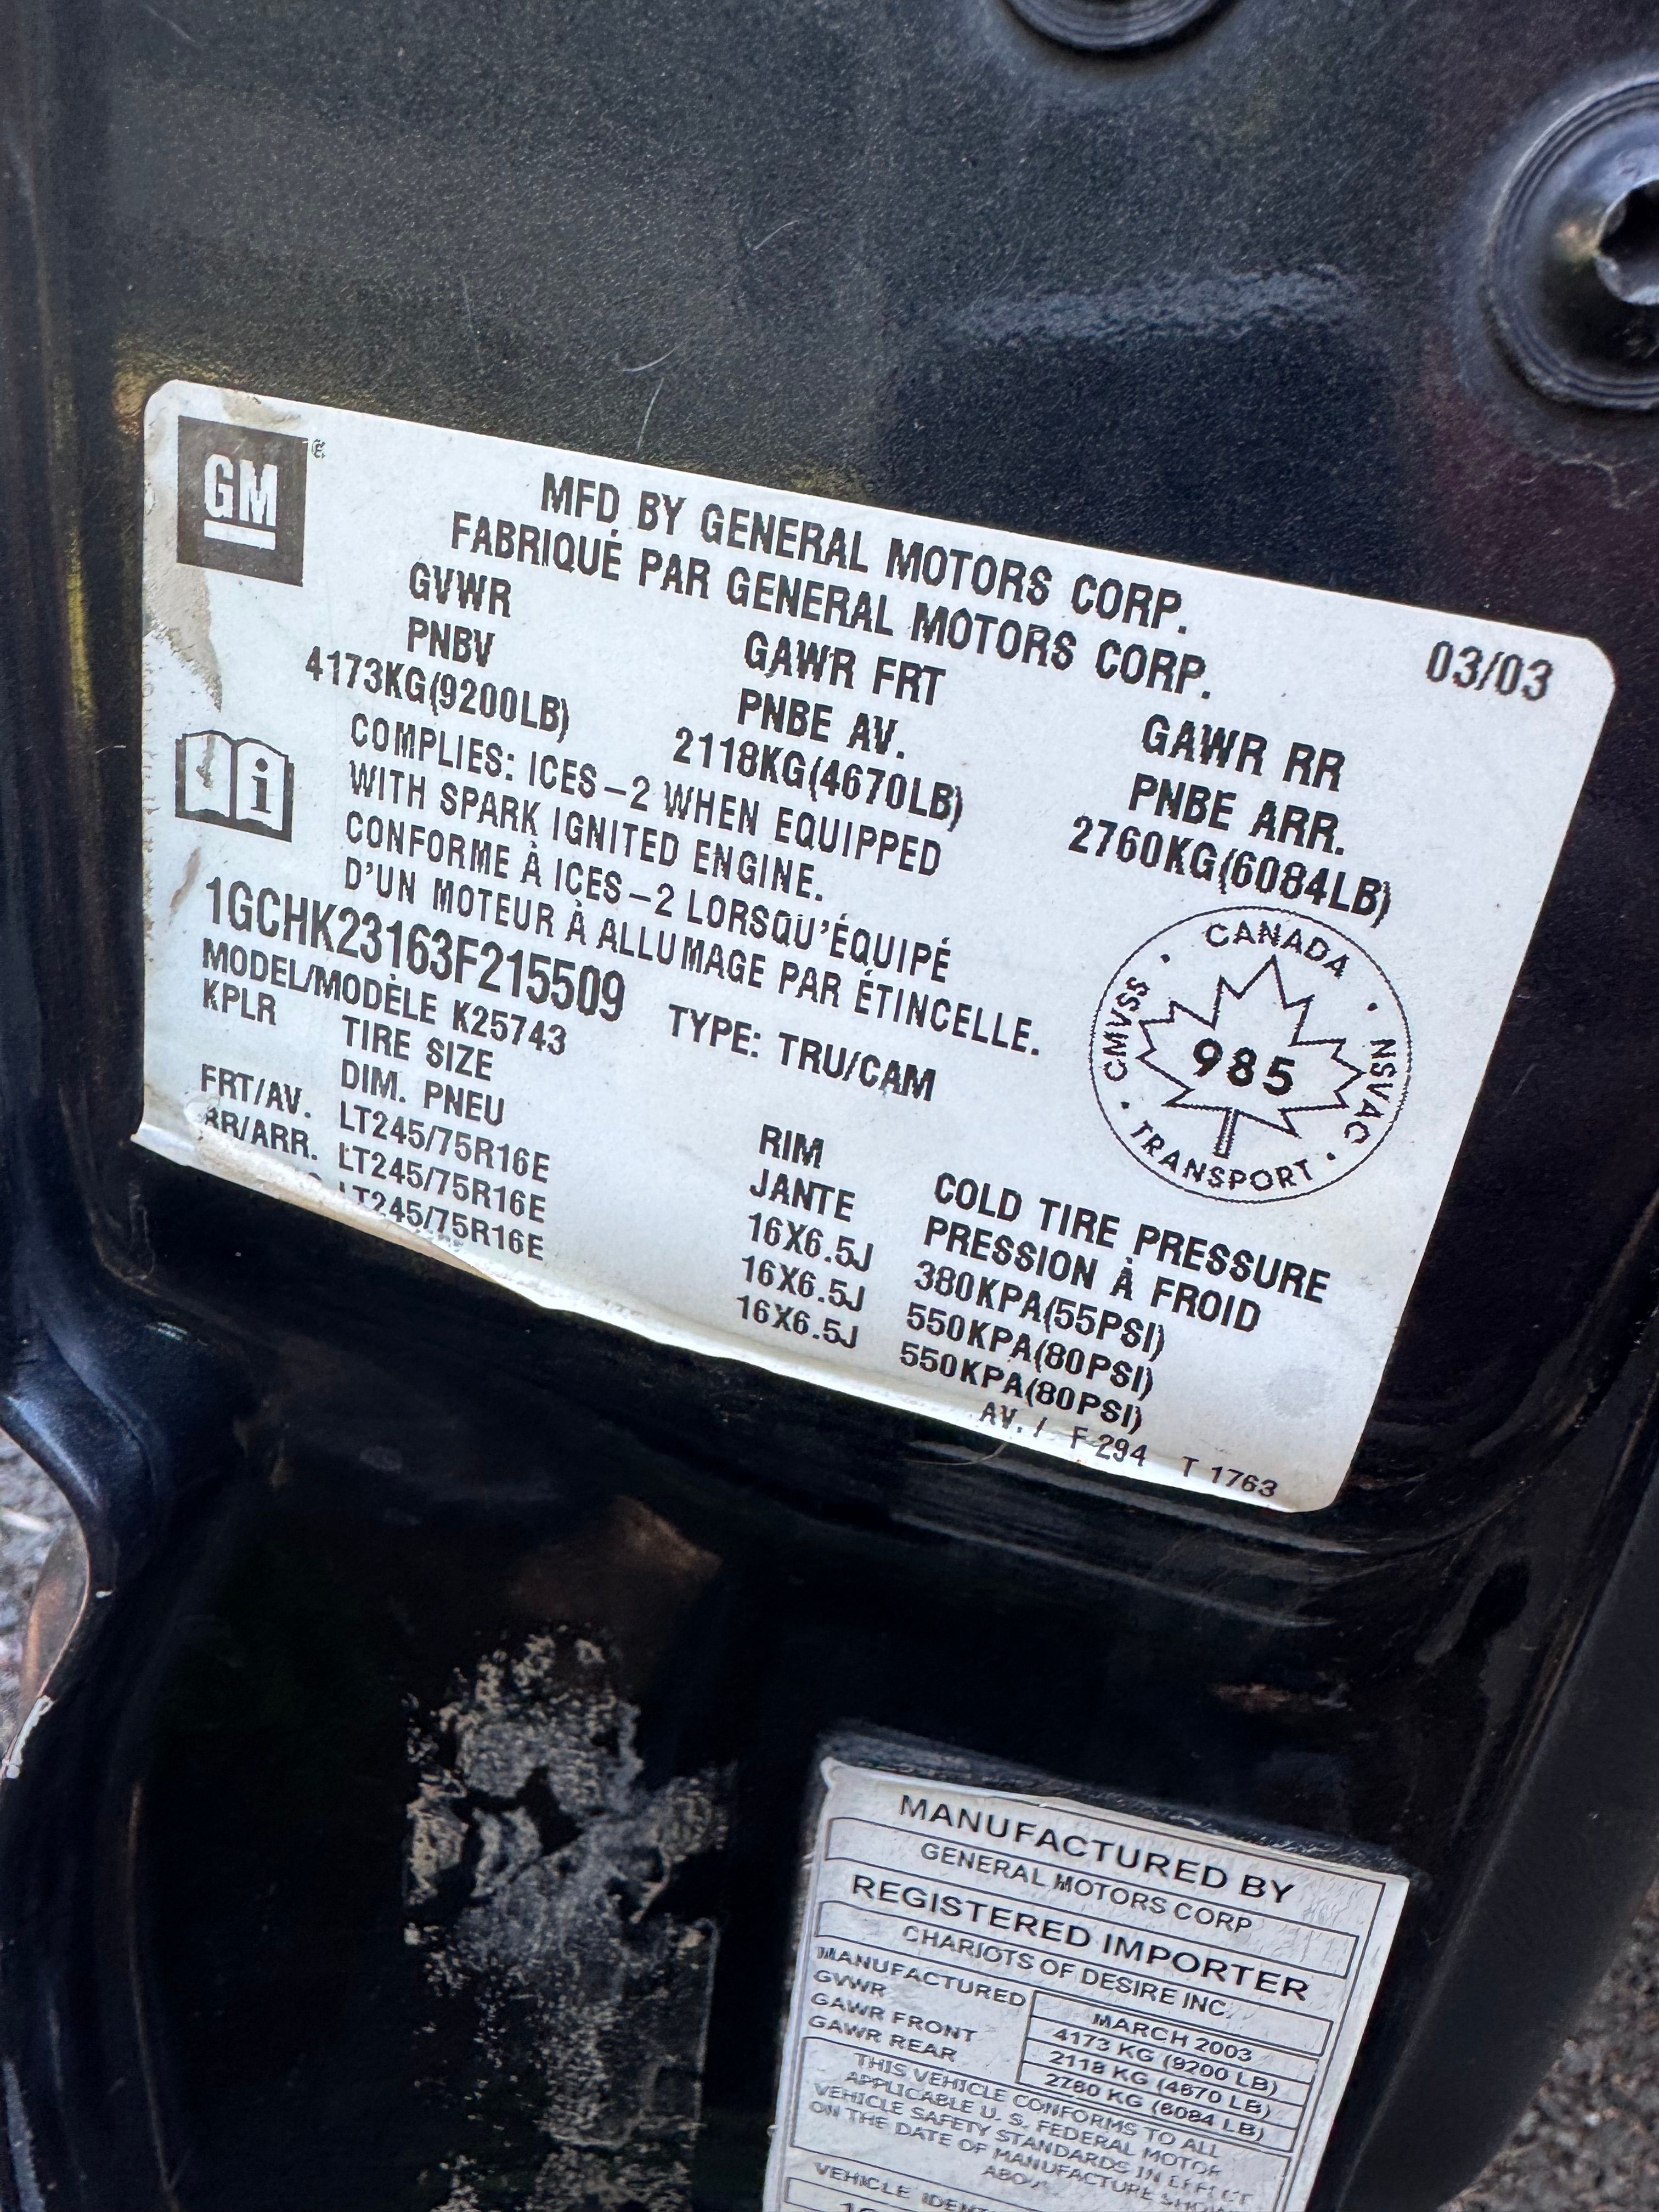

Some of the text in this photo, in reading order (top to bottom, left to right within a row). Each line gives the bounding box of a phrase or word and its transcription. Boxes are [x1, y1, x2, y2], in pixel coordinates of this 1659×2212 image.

[204, 454, 278, 527] GM
[409, 562, 511, 618] GVWR
[541, 472, 1187, 634] MFD BY GENERAL MOTORS CORP.
[408, 617, 495, 667] PNBV
[452, 511, 1210, 699] FABRIQUÉ PAR GENERAL MOTORS CORP.
[306, 646, 569, 743] 4173KG(9200LB)
[744, 630, 946, 706] GAWR FRT
[1426, 641, 1554, 701] 03/03
[737, 688, 904, 759] PNBE AV.
[1141, 714, 1345, 792] GAWR RR
[351, 713, 514, 781] COMPLIES:
[664, 781, 759, 836] WHEN
[775, 806, 941, 876] EQUIPPED
[673, 726, 963, 832] 2118KG(4670LB)
[1128, 773, 1344, 855] PNBE ARR.
[346, 810, 510, 879] CONFORME
[520, 840, 541, 887] À
[349, 760, 822, 901] WITH SPARK IGNITED ENGINE.
[1068, 815, 1391, 929] 2760KG(6084LB)
[206, 877, 625, 1022] 1GCHK23163F215509
[345, 856, 1039, 1056] D'UN MOTEUR À ALLUMAGE PAR ÉTINCELLE.
[1205, 920, 1350, 979] CANADA
[202, 938, 567, 1056] MODEL/MODÈLE K25743
[203, 978, 276, 1025] KPLR
[1102, 976, 1150, 1082] CMVSS
[342, 1015, 493, 1081] TIRE SIZE
[669, 1003, 936, 1102] TYPE: TRU/CAM
[1193, 1038, 1295, 1096] 985
[201, 1064, 311, 1118] FRT/AV.
[341, 1059, 504, 1126] DIM. PNEU
[1344, 1038, 1396, 1144] NSVAC
[339, 1101, 550, 1184] LT245/75R16E
[759, 1124, 824, 1169] RIM
[1130, 1120, 1315, 1191] TRANSPORT
[338, 1142, 546, 1224] LT245/75R16E
[749, 1169, 855, 1222] JANTE
[748, 1212, 873, 1272] 16X6.5J
[924, 1215, 1261, 1332] PRESSION À FROID
[934, 1172, 1331, 1304] COLD TIRE PRESSURE
[737, 1295, 859, 1349] 16X6.5J
[742, 1256, 865, 1312] 16X6.5J
[914, 1260, 1165, 1362] 380KPA(55PSI)
[899, 1339, 1144, 1437] 550KPA(80PSI)
[905, 1302, 1153, 1401] 550KPA(80PSI)
[979, 1402, 1023, 1433] AV.
[1070, 1426, 1088, 1449] F
[1096, 1434, 1148, 1467] 294
[1182, 1456, 1199, 1477] T
[1211, 1466, 1278, 1497] 1763
[899, 1795, 1295, 1904] MANUFACTURED BY
[921, 1842, 1252, 1933] GENERAL MOTORS CORP
[816, 1947, 1026, 2006] MANUFACTURED
[853, 1875, 1310, 2001] REGISTERED IMPORTER
[902, 1925, 1034, 1970] CHARIOTS
[1040, 1959, 1076, 1979] OF
[1080, 1968, 1175, 2005] DESIRE
[810, 1993, 978, 2042] GAWR FRONT
[813, 1970, 886, 1997] GVWR
[809, 2015, 957, 2062] GAWR REAR
[1053, 2029, 1110, 2051] 4173
[1117, 2042, 1153, 2062] KG
[1234, 2072, 1278, 2097] LB)
[1092, 2013, 1252, 2062] MARCH 2003
[844, 2072, 974, 2113] APPLICABLE
[1036, 2120, 1136, 2156] FEDERAL
[854, 2052, 1222, 2158] THIS VEHICLE CONFORMS TO ALL
[1048, 2051, 1105, 2074] 2118
[1111, 2066, 1149, 2085] KG
[1228, 2095, 1271, 2120] LB)
[1106, 2088, 1143, 2108] KG
[1222, 2118, 1264, 2142] LB)
[809, 2101, 840, 2117] ON
[845, 2107, 888, 2129] THE
[895, 2123, 953, 2146] DATE
[957, 2138, 986, 2155] OF
[814, 2083, 904, 2115] VEHICLE
[910, 2107, 992, 2137] SAFETY
[995, 2130, 1131, 2174] STANDARDS
[1136, 2166, 1160, 2182] IN
[813, 2162, 911, 2199] VEHICLE
